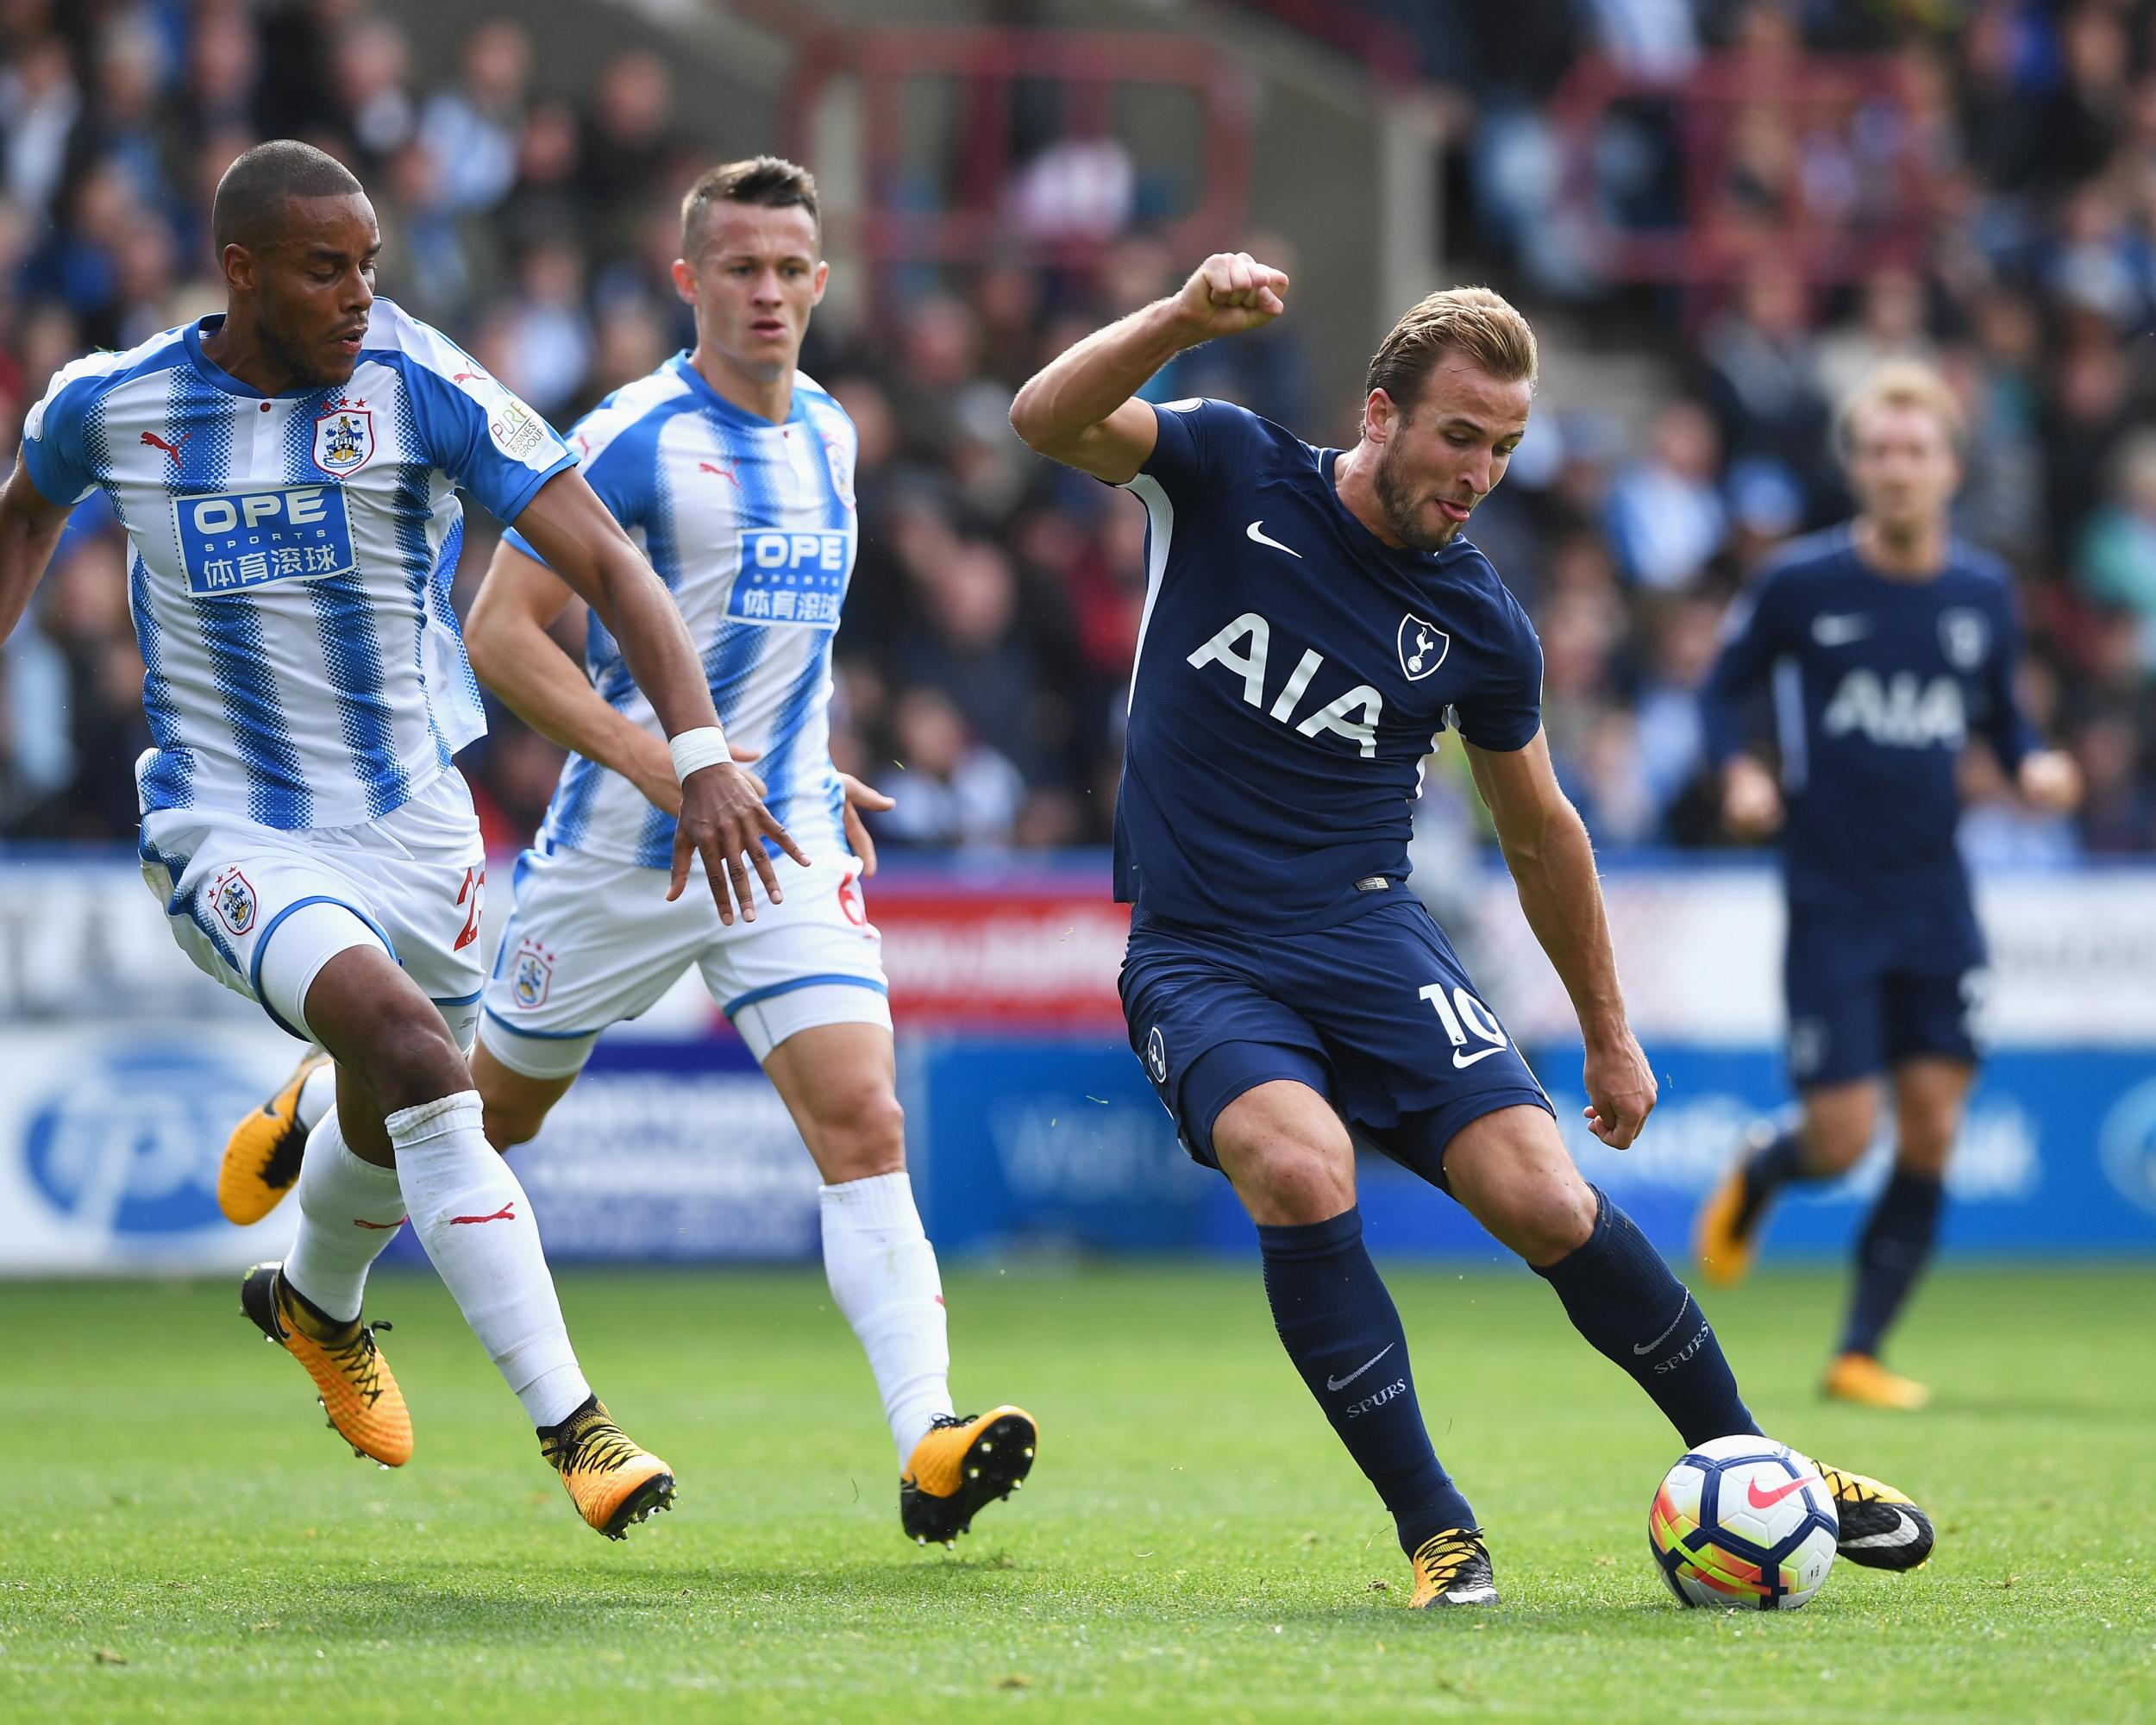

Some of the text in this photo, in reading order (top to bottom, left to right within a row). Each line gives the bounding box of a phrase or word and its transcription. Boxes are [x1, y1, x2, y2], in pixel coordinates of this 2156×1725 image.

[491, 402, 528, 444] PURE
[519, 428, 544, 457] GROUP
[194, 488, 327, 535] OPE
[205, 530, 325, 551] SPORTS
[755, 535, 842, 570] OPE
[204, 544, 337, 588] 体育滚球
[1187, 612, 1382, 757] AIA
[1419, 983, 1507, 1046] 10
[1654, 1320, 1708, 1374] SPURS
[1347, 1378, 1406, 1418] SPURS
